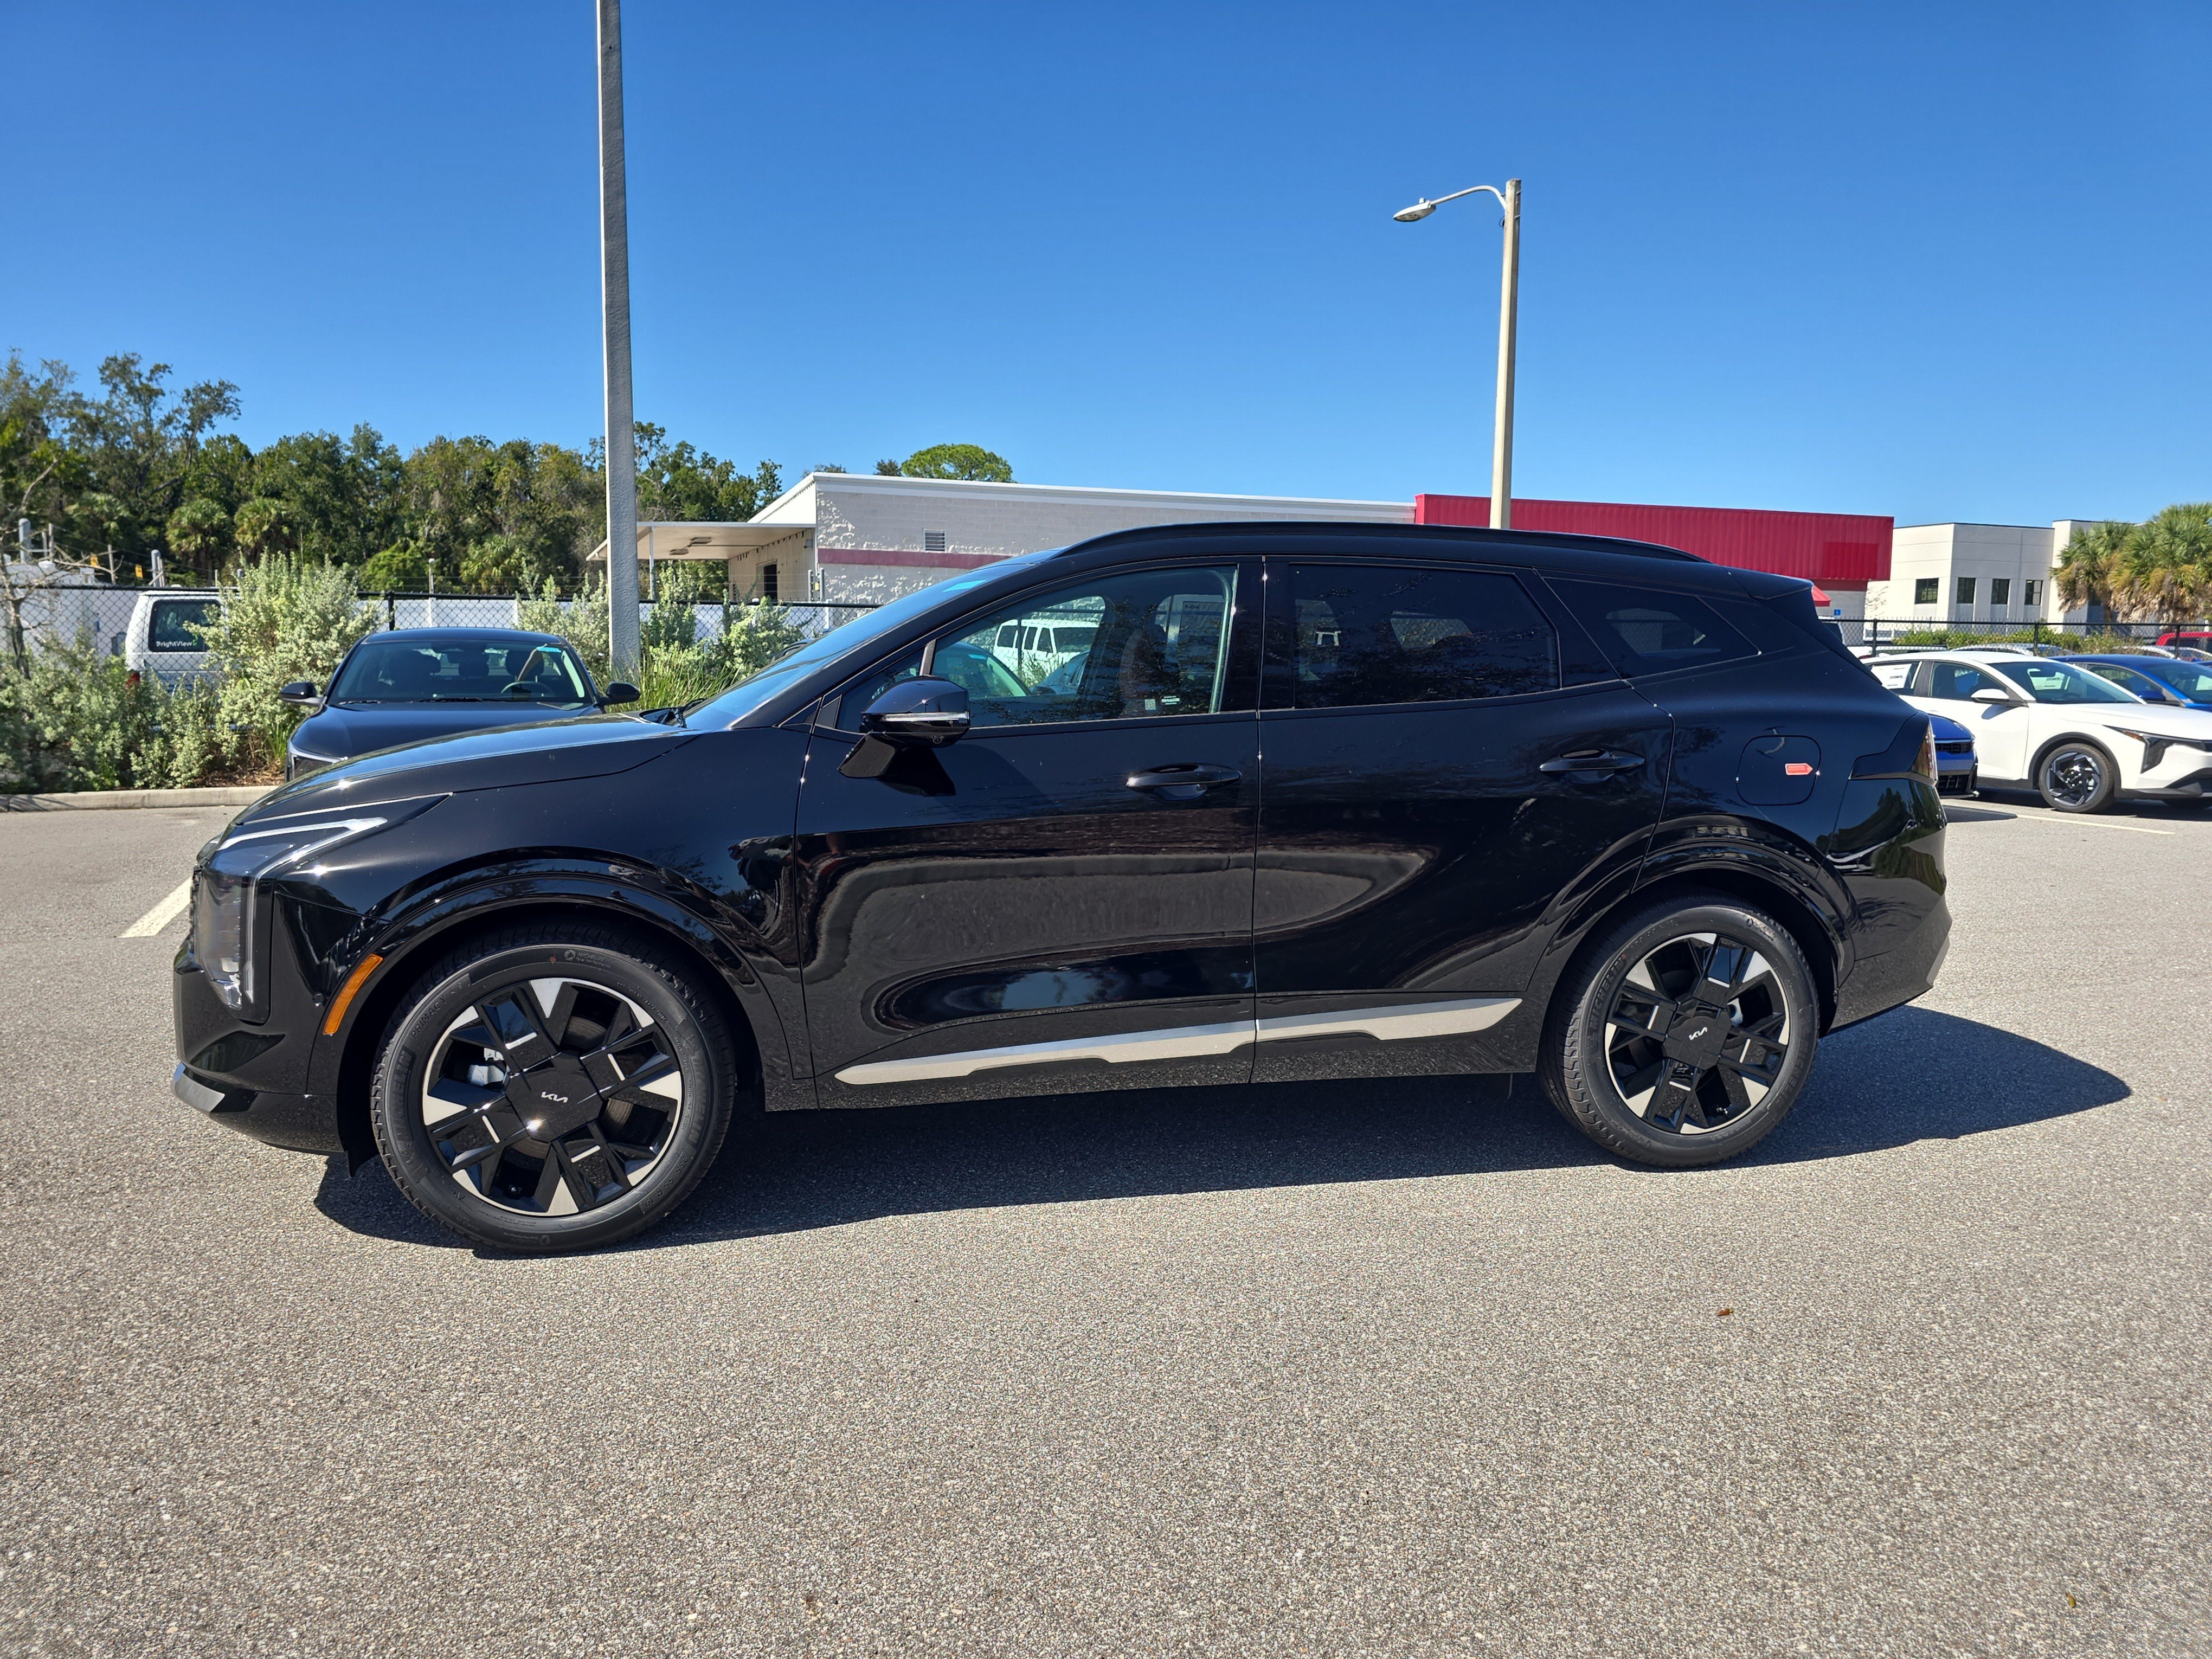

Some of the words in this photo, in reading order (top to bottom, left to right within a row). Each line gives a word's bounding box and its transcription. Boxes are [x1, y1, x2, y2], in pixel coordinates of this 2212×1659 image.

[410, 994, 446, 1039] PRIMACY
[1589, 957, 1626, 1030] MICHELIN
[1689, 1027, 1707, 1040] KIA
[393, 1050, 413, 1141] MICHELIN
[541, 1091, 568, 1103] KIA
[688, 1058, 706, 1144] MICHELIN
